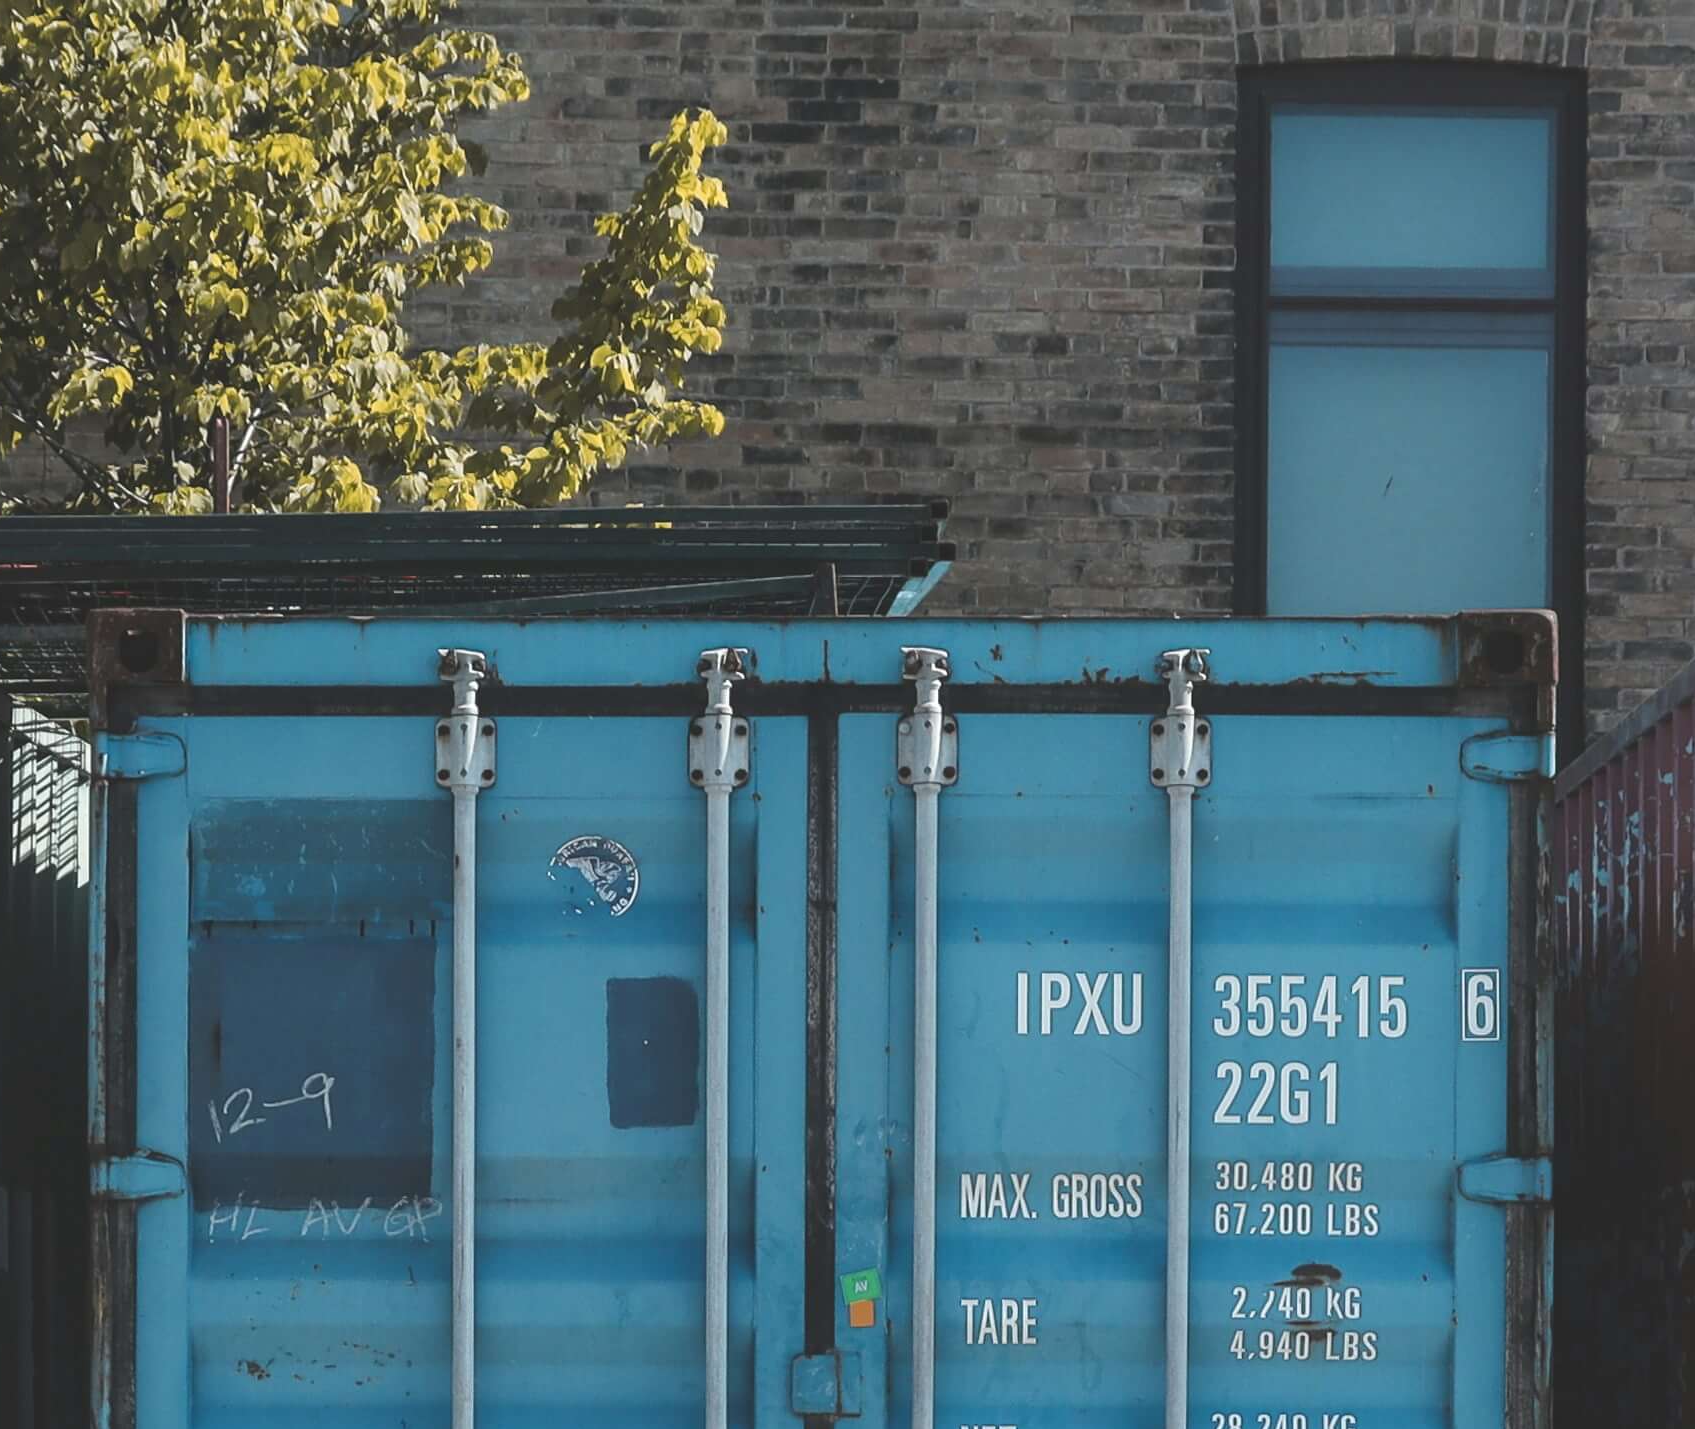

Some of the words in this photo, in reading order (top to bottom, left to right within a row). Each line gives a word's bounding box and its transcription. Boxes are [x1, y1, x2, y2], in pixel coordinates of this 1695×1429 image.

[1017, 972, 1143, 1035] IPXU
[1213, 975, 1407, 1039] 355415
[1468, 974, 1494, 1036] 6
[1213, 1062, 1338, 1125] 22G1
[961, 1173, 1037, 1219] MAX.
[1052, 1173, 1142, 1219] GROSS
[1216, 1161, 1312, 1192] 30,480
[1328, 1162, 1363, 1192] KG
[1215, 1203, 1311, 1235] 67,200
[1327, 1203, 1379, 1236] LBS
[961, 1299, 1037, 1344] TARE
[1326, 1287, 1362, 1319] KG
[1230, 1330, 1310, 1361] 4,940
[1326, 1331, 1378, 1360] LBS
